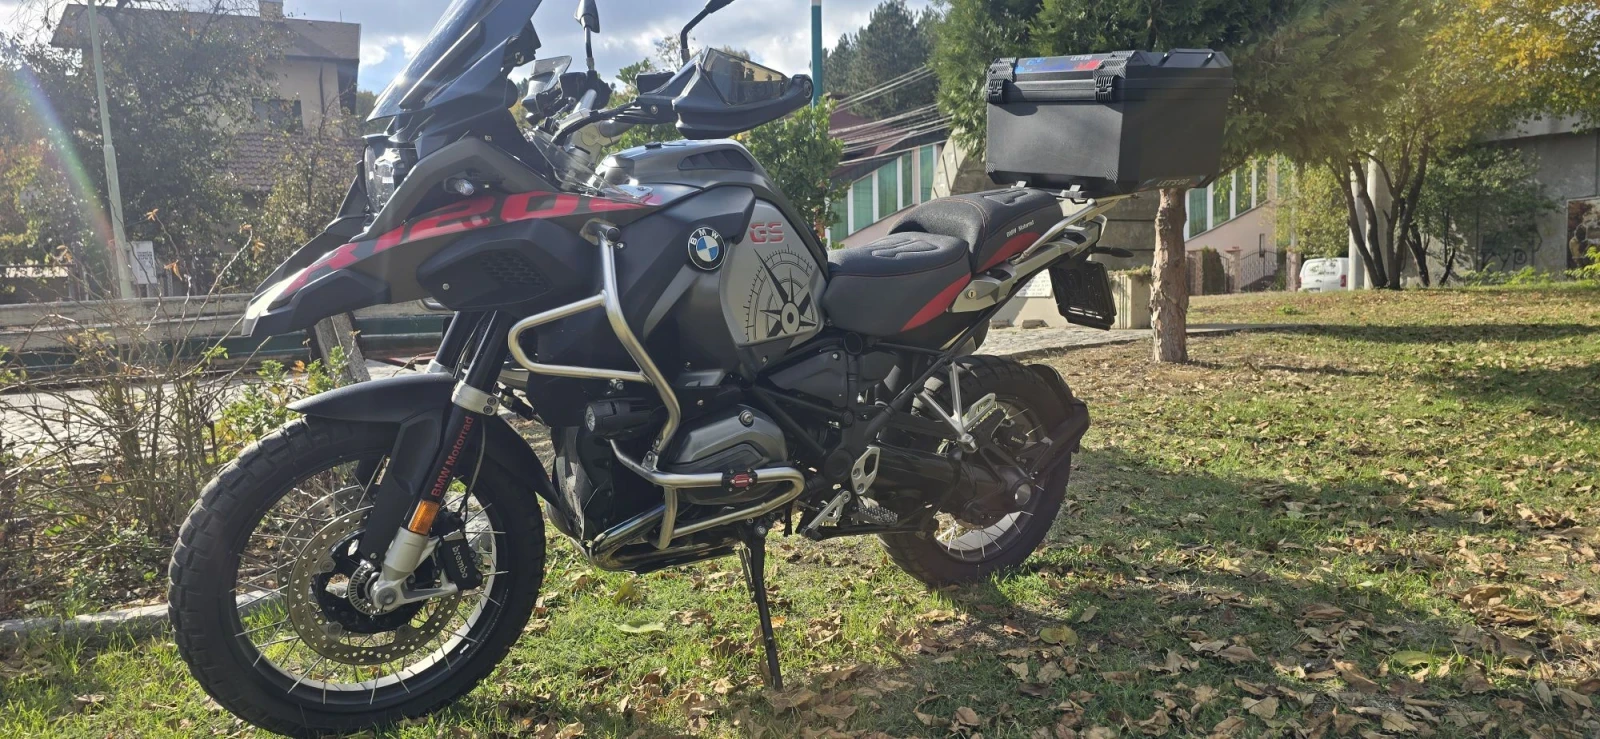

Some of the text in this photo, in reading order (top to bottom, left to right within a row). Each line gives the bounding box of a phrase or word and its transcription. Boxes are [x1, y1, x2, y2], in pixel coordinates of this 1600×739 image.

[690, 229, 719, 245] BMW
[749, 222, 784, 244] GS
[431, 416, 474, 497] BMW Motorrad
[452, 545, 468, 579] brembo
